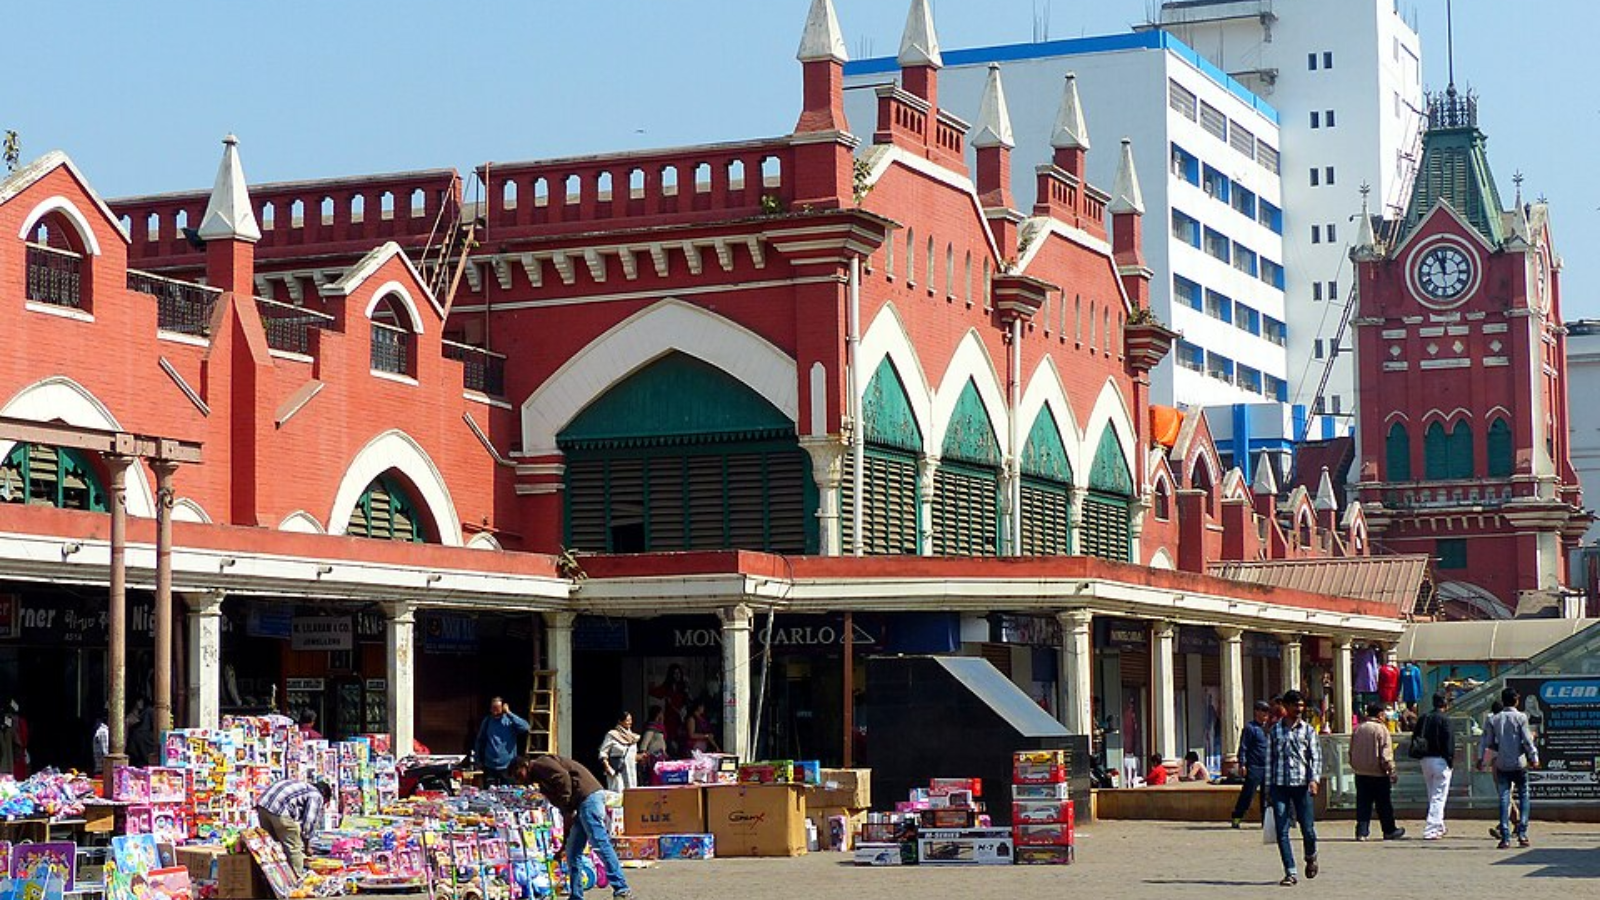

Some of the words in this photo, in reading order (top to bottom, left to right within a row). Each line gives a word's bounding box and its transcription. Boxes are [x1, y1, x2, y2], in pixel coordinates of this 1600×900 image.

[20, 608, 56, 627] rner
[674, 629, 723, 646] MON
[758, 626, 836, 646] CARLO
[1545, 773, 1586, 782] Harbinger
[641, 813, 671, 823] LUX
